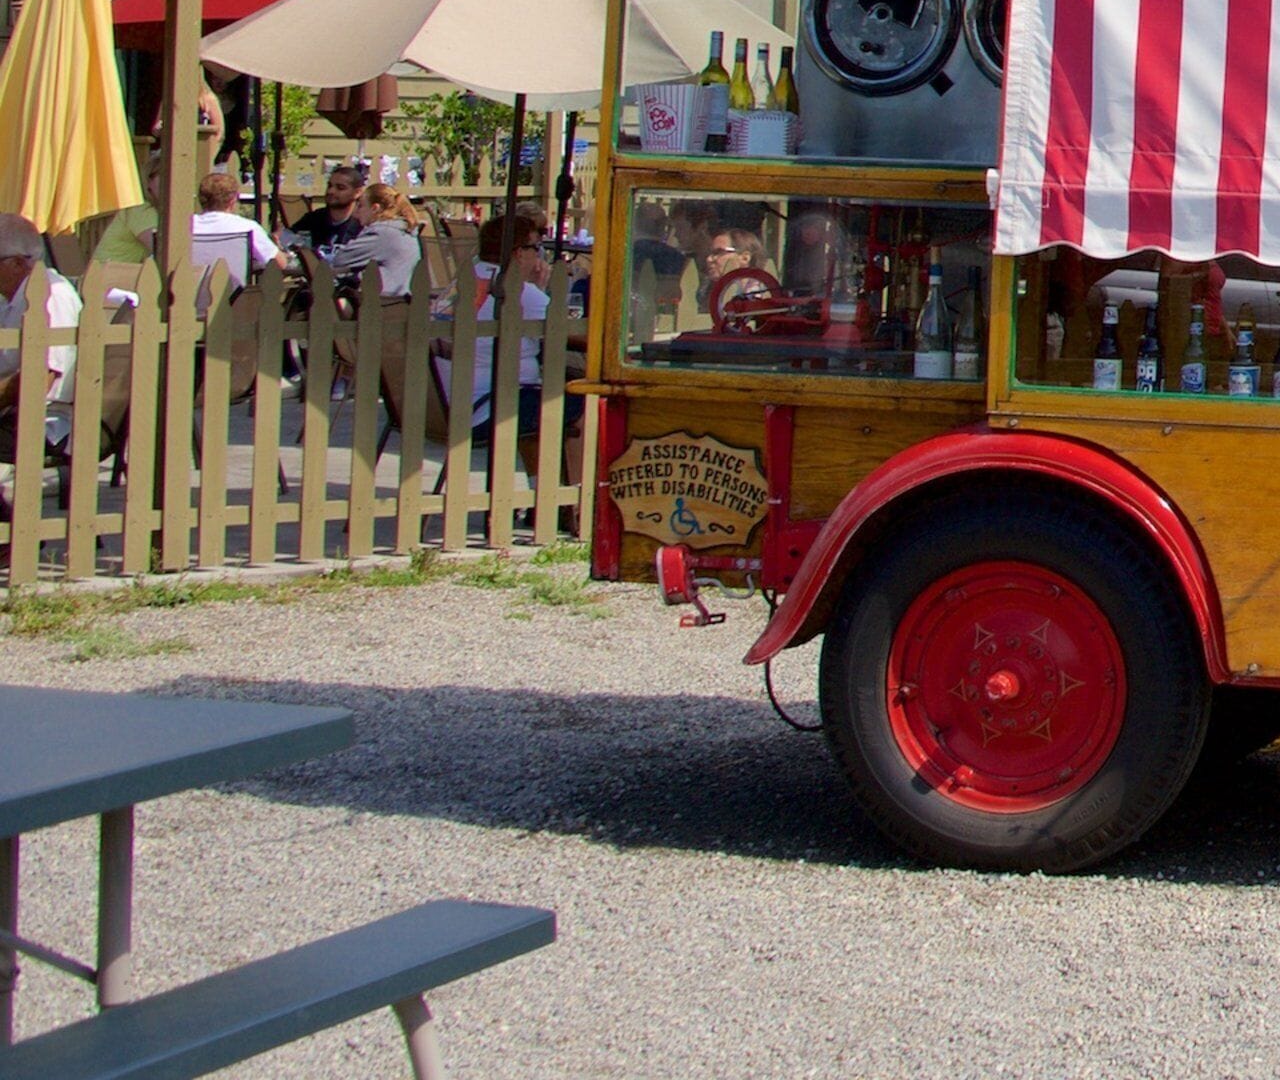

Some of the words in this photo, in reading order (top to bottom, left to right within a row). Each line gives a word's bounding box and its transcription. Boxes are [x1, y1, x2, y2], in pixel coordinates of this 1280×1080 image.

[641, 444, 746, 474] ASSISTANCE
[609, 462, 674, 486] OFFERED
[679, 463, 699, 480] TO
[703, 467, 768, 505] PERSONS
[611, 482, 656, 500] WITH
[661, 480, 759, 518] DISABILITIES
